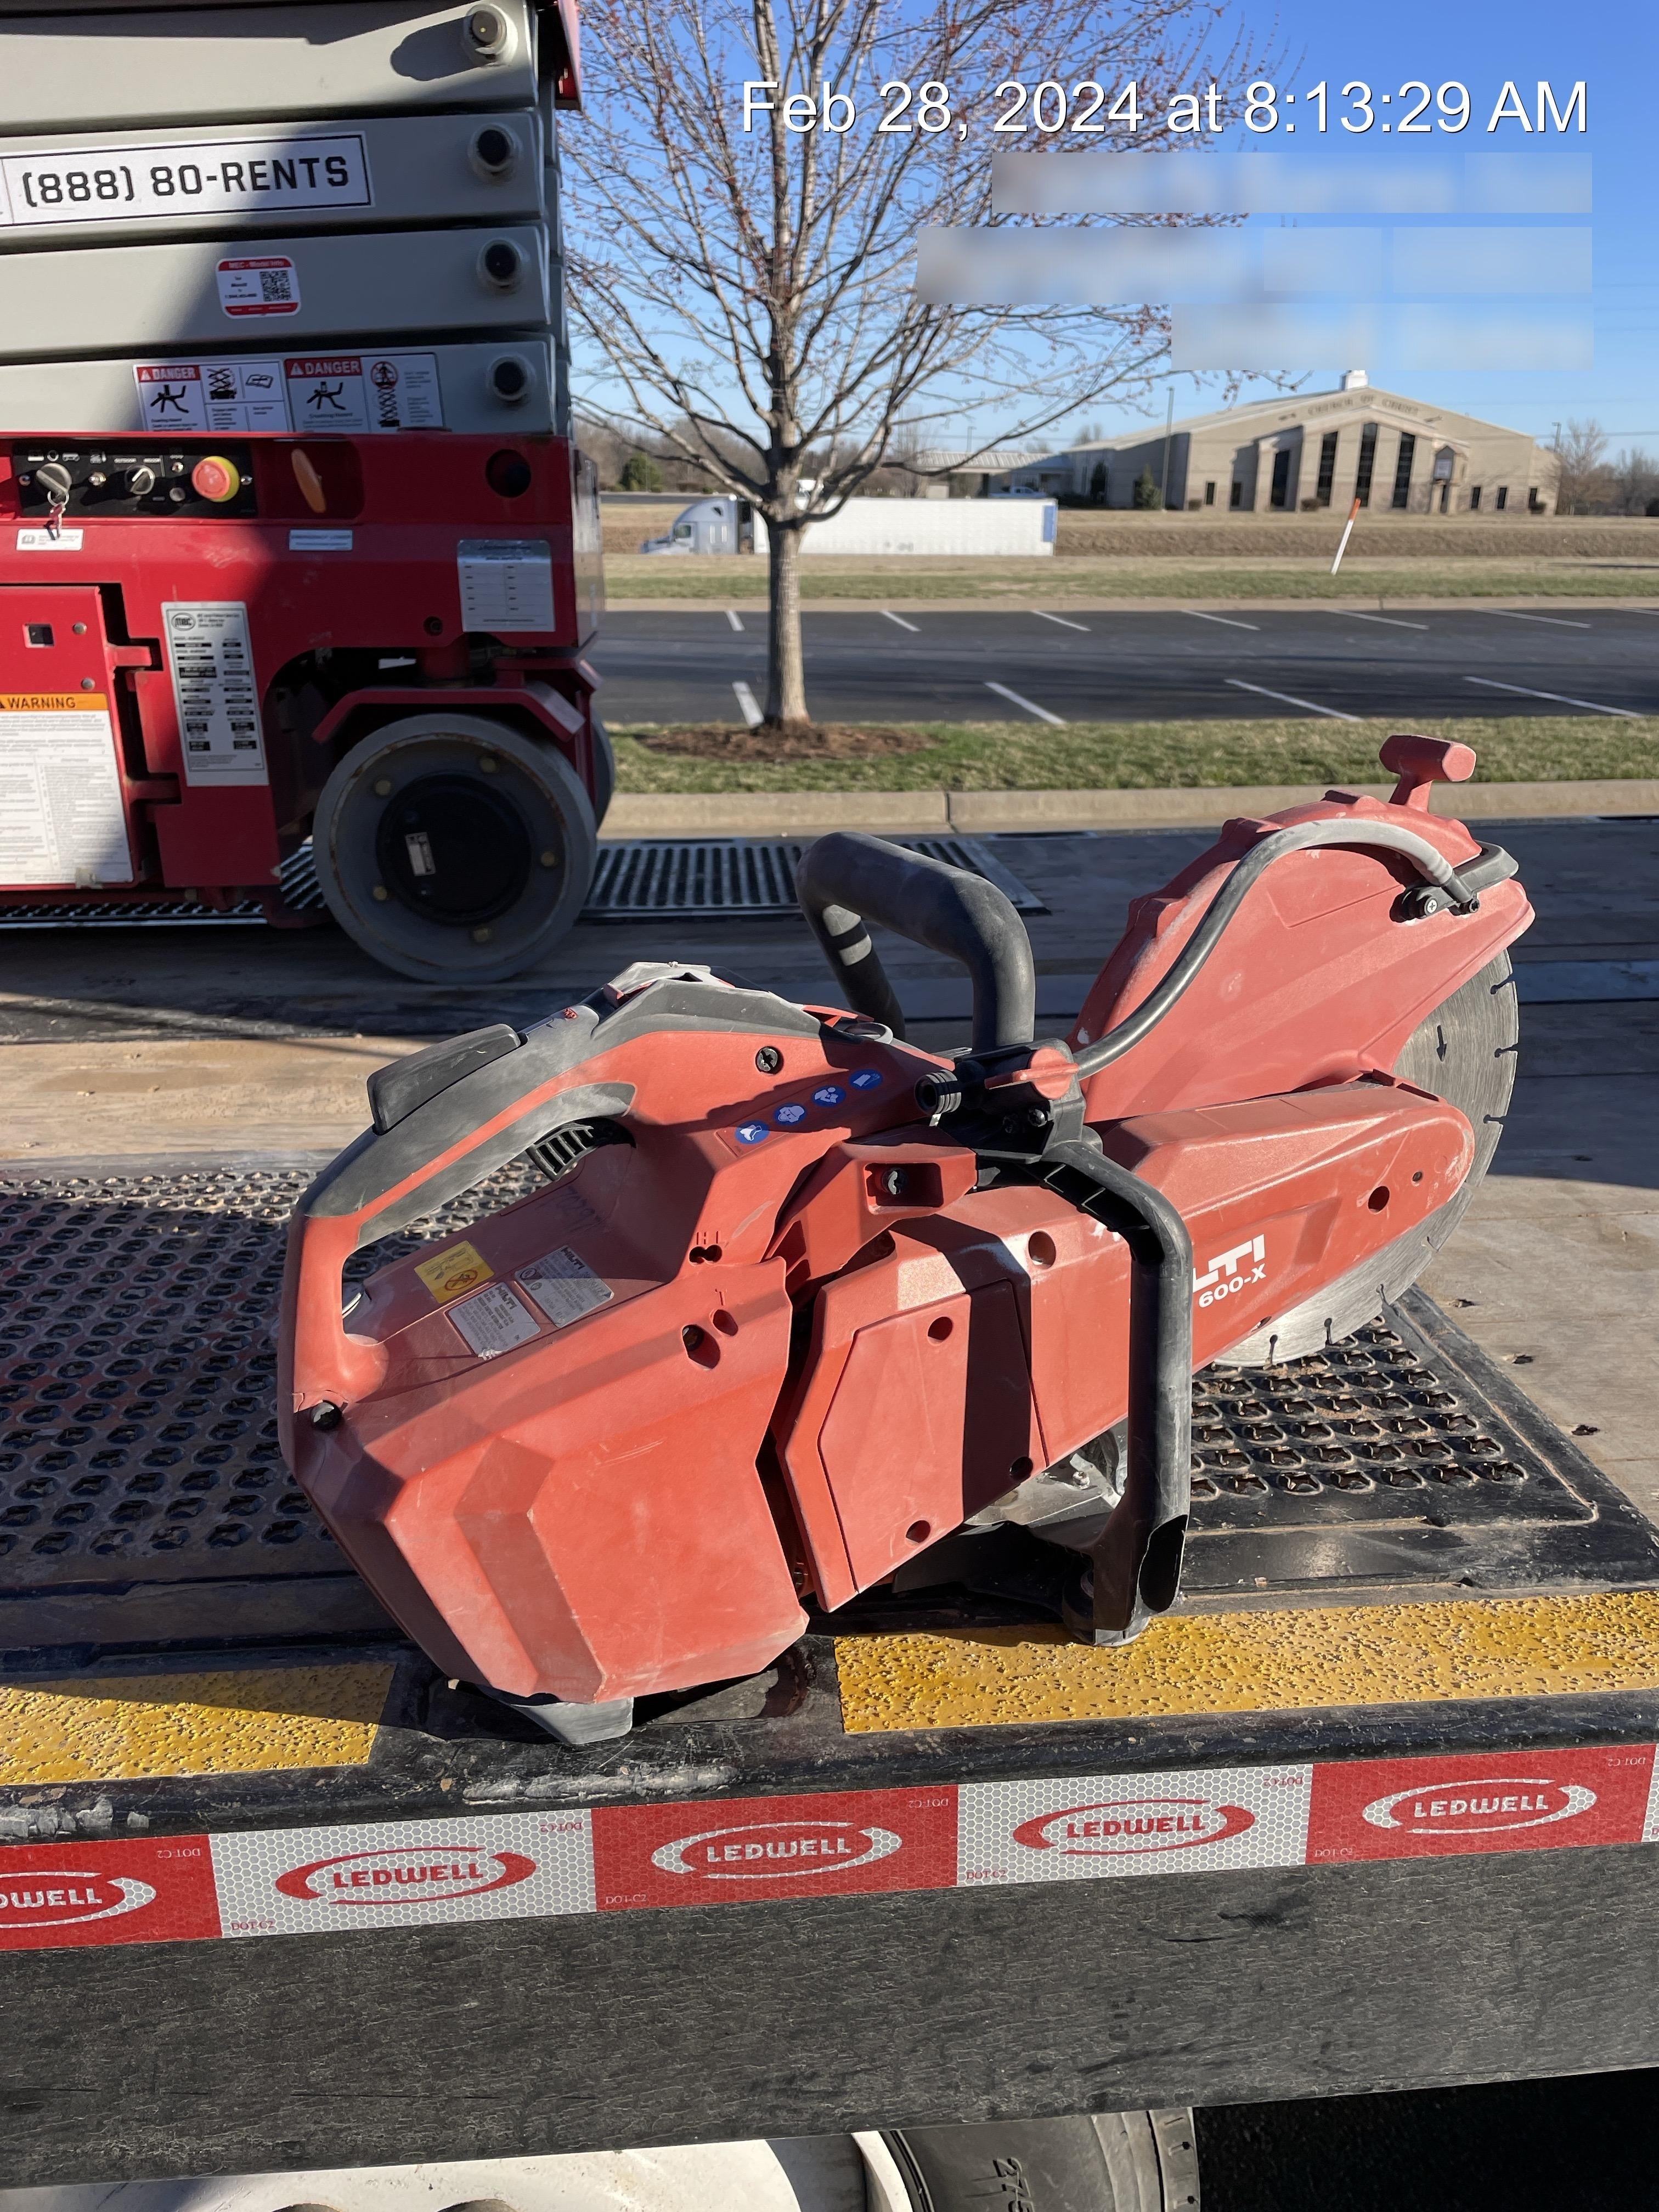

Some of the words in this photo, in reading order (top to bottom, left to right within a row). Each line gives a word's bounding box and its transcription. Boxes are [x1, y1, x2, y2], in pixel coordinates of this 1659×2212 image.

[22, 166, 134, 207] (888)
[150, 155, 349, 196] 80-RENTS
[152, 366, 196, 380] DANGER
[304, 360, 361, 374] DANGER
[7, 697, 76, 709] WARNING
[1192, 1234, 1265, 1294] LTI
[495, 1285, 518, 1310] HILTI
[1198, 1263, 1267, 1308] 600-X
[1413, 1794, 1550, 1819] LEDWELL
[1066, 1814, 1206, 1839] LEDWELL
[706, 1837, 852, 1863] LEDWELL
[334, 1863, 484, 1889] LEDWELL
[0, 1888, 103, 1909] WELL
[605, 1894, 647, 1904] DOT-C2
[231, 1920, 274, 1931] DOT-C2
